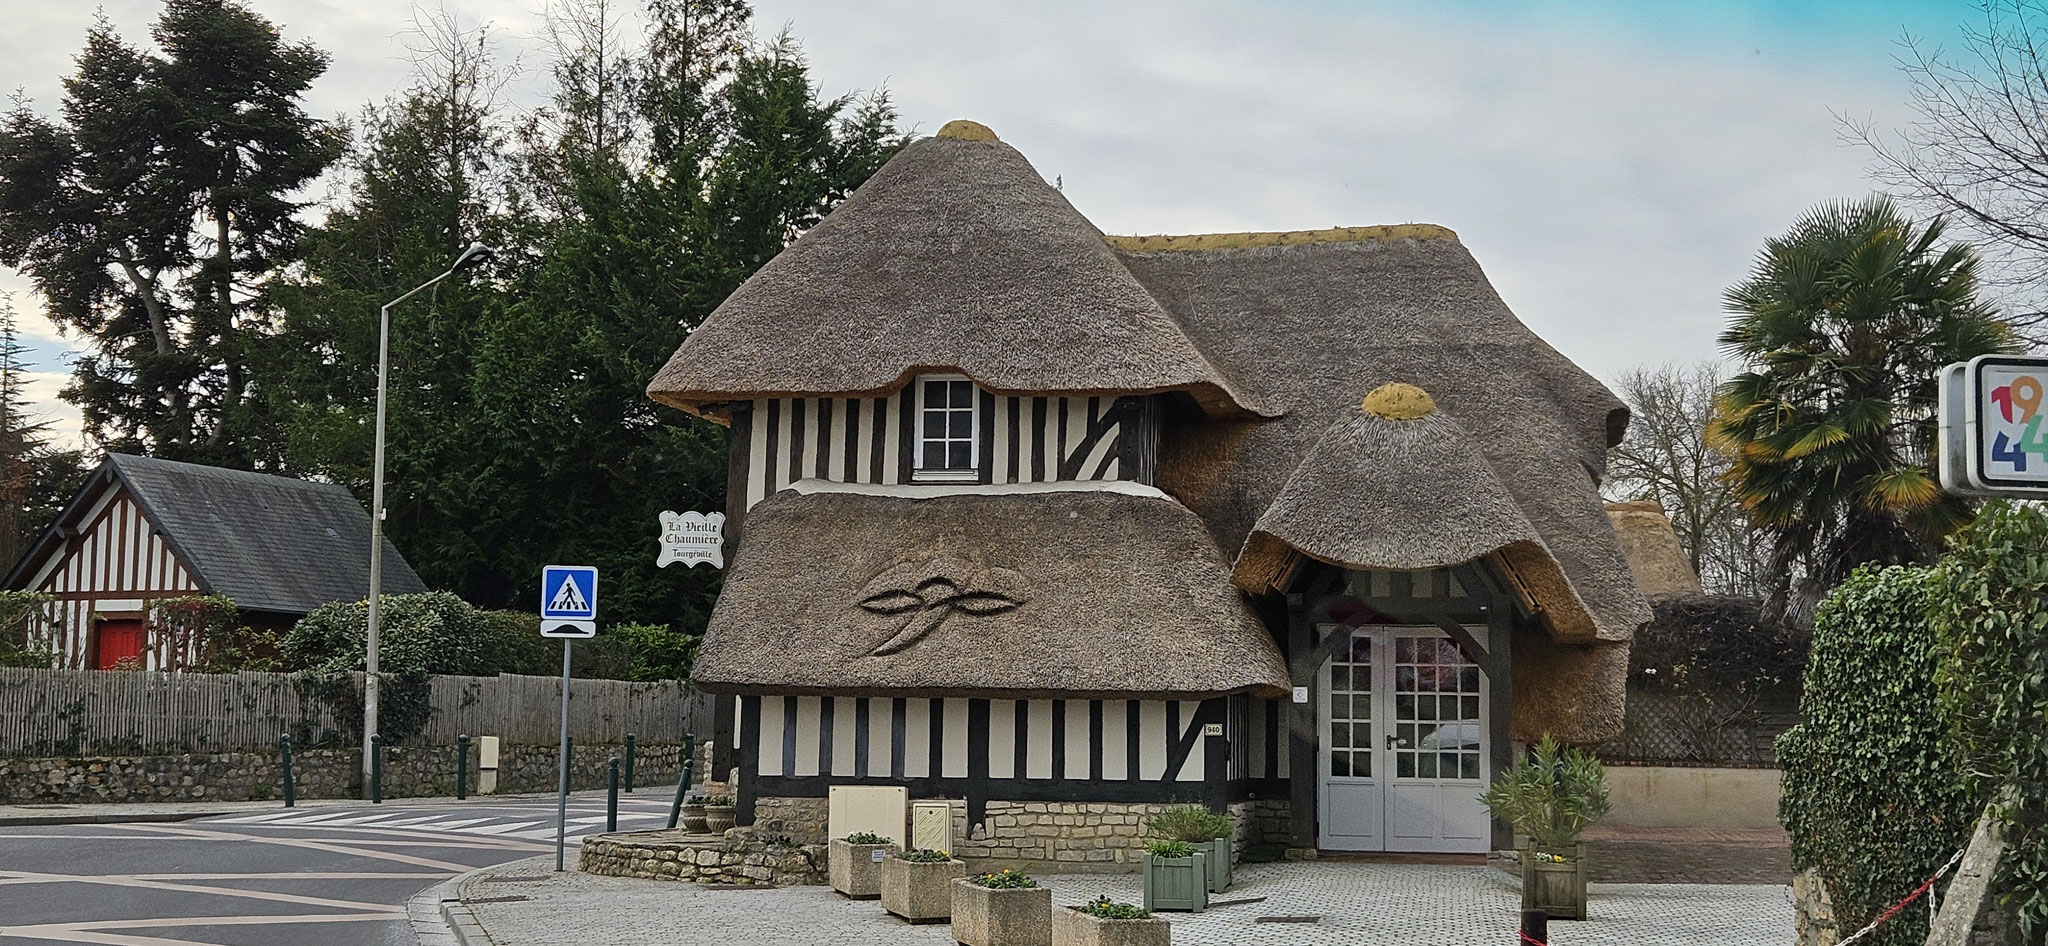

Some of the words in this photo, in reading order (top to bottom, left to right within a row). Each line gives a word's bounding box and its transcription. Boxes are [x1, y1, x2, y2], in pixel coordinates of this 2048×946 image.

[1991, 375, 2043, 424] 19
[667, 521, 681, 532] La
[686, 521, 717, 532] Vieille
[665, 533, 719, 545] Chaumière
[672, 549, 712, 559] Tourgéville
